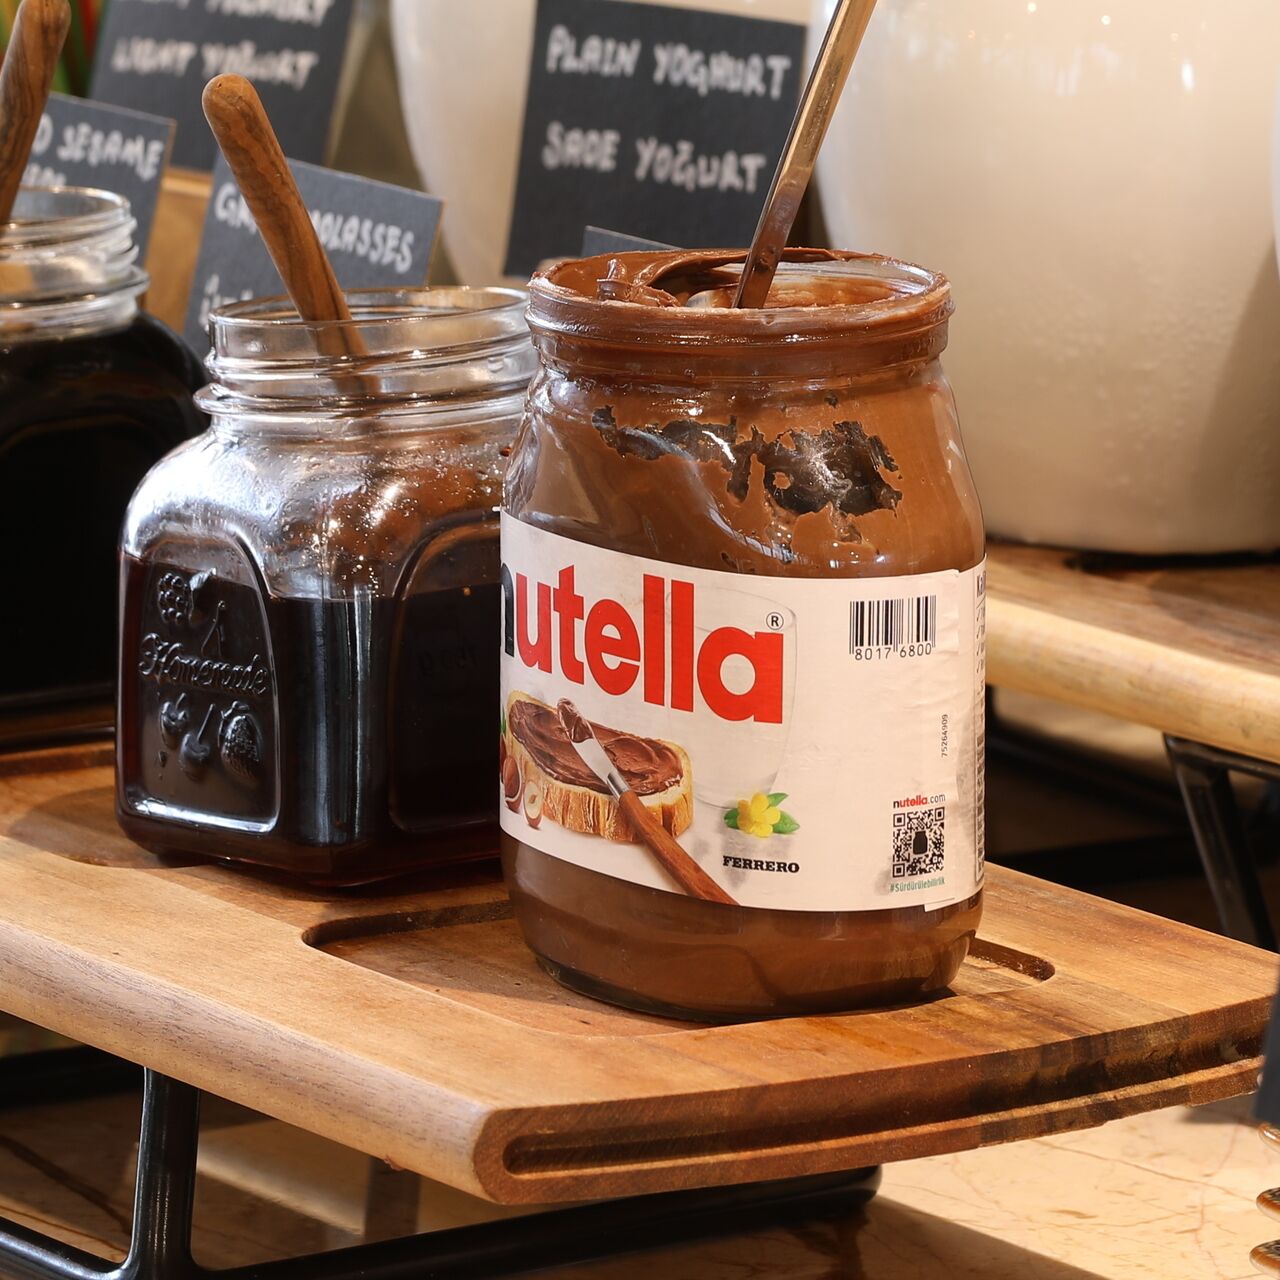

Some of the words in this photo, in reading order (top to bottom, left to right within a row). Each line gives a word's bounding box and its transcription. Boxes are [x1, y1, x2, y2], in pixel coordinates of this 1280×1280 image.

[546, 23, 642, 78] PLAIN
[652, 42, 792, 101] YOGHURT
[56, 121, 166, 183] SESAME
[308, 209, 415, 275] OLASSES
[854, 647, 892, 661] 8017
[899, 642, 933, 659] 6800
[893, 793, 946, 809] nutella.com
[722, 854, 801, 874] FERRERO
